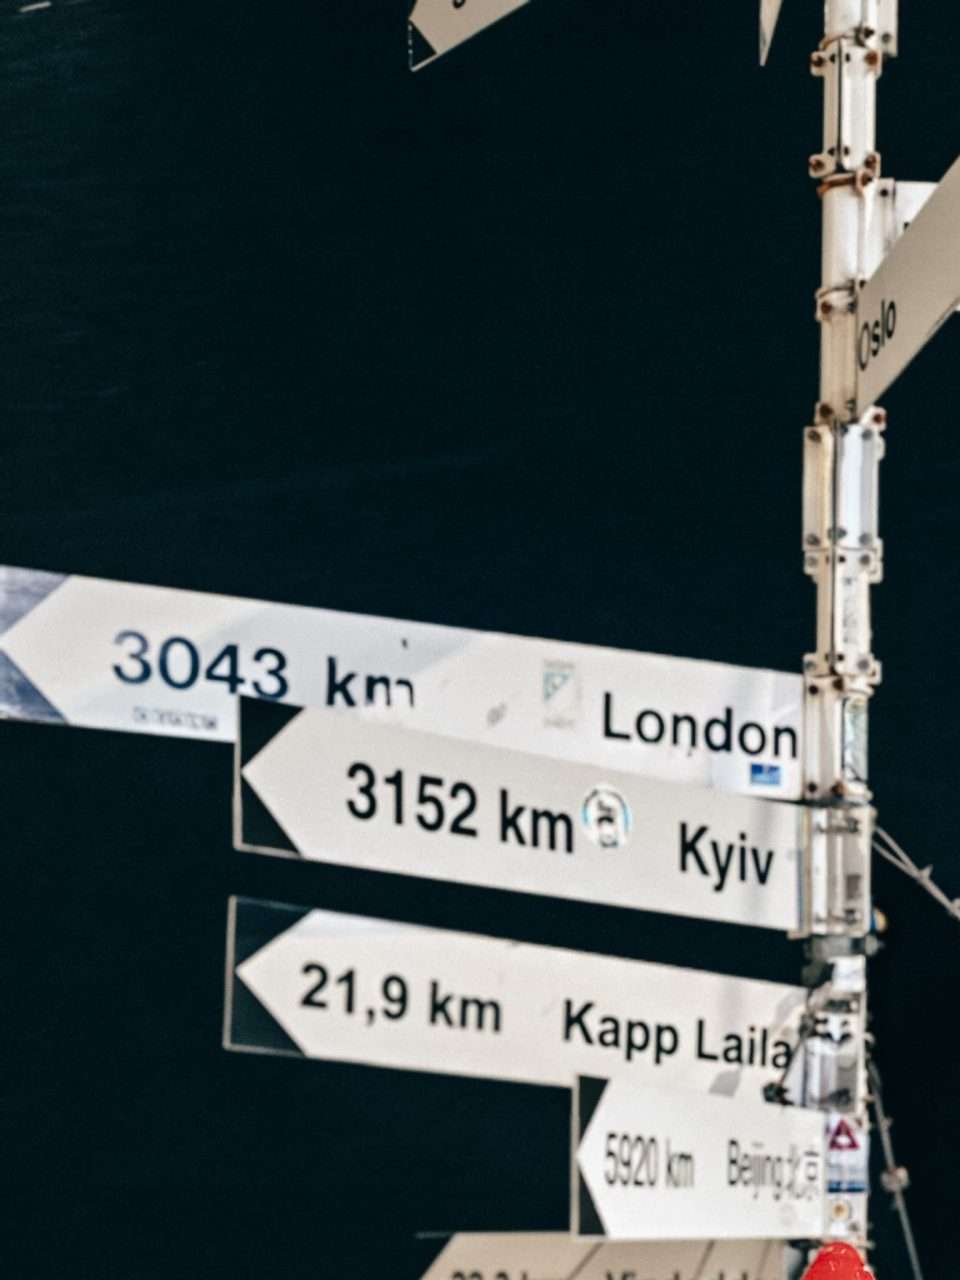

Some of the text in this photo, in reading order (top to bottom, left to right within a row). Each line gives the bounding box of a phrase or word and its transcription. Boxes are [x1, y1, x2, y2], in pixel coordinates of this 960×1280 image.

[857, 299, 896, 372] Oslo
[112, 631, 797, 758] 3043 km London
[347, 762, 774, 892] 3152 km Kyiv
[301, 963, 793, 1069] 21,9 km Kapp Laila
[604, 1131, 658, 1187] 5920
[665, 1139, 695, 1188] km
